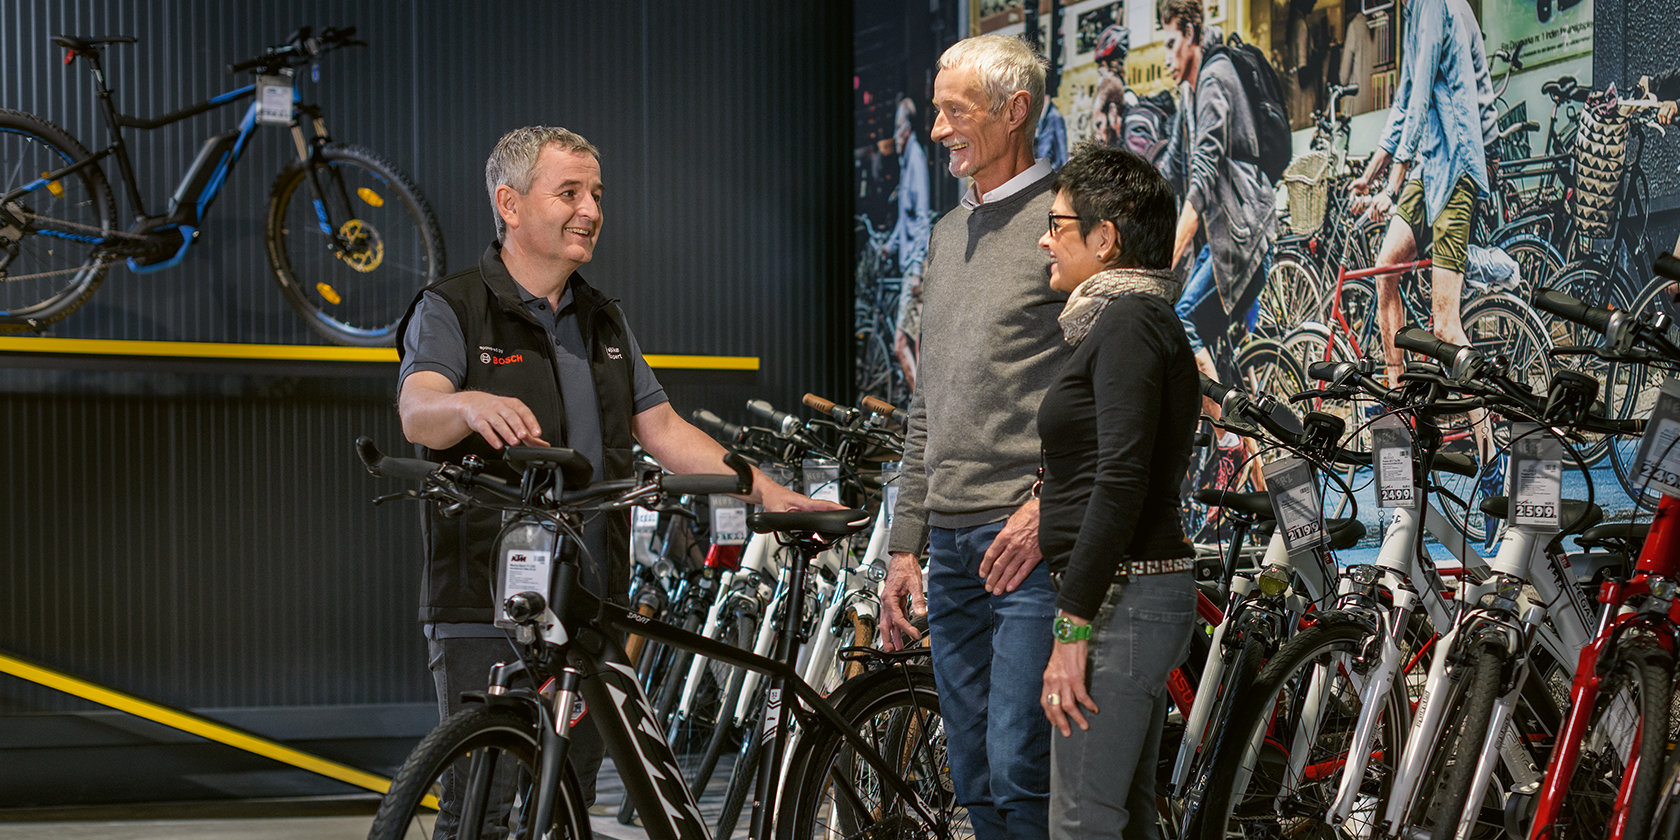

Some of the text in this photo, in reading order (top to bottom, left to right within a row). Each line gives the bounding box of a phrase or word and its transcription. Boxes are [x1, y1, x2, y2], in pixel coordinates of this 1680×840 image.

[492, 354, 523, 365] BOSCH
[1641, 463, 1680, 487] 249
[1381, 489, 1410, 500] 2499
[1515, 505, 1554, 518] 2599
[1287, 521, 1320, 542] 2199
[511, 554, 526, 562] KTM
[1572, 581, 1596, 628] PEGAS
[627, 612, 650, 624] SPORT
